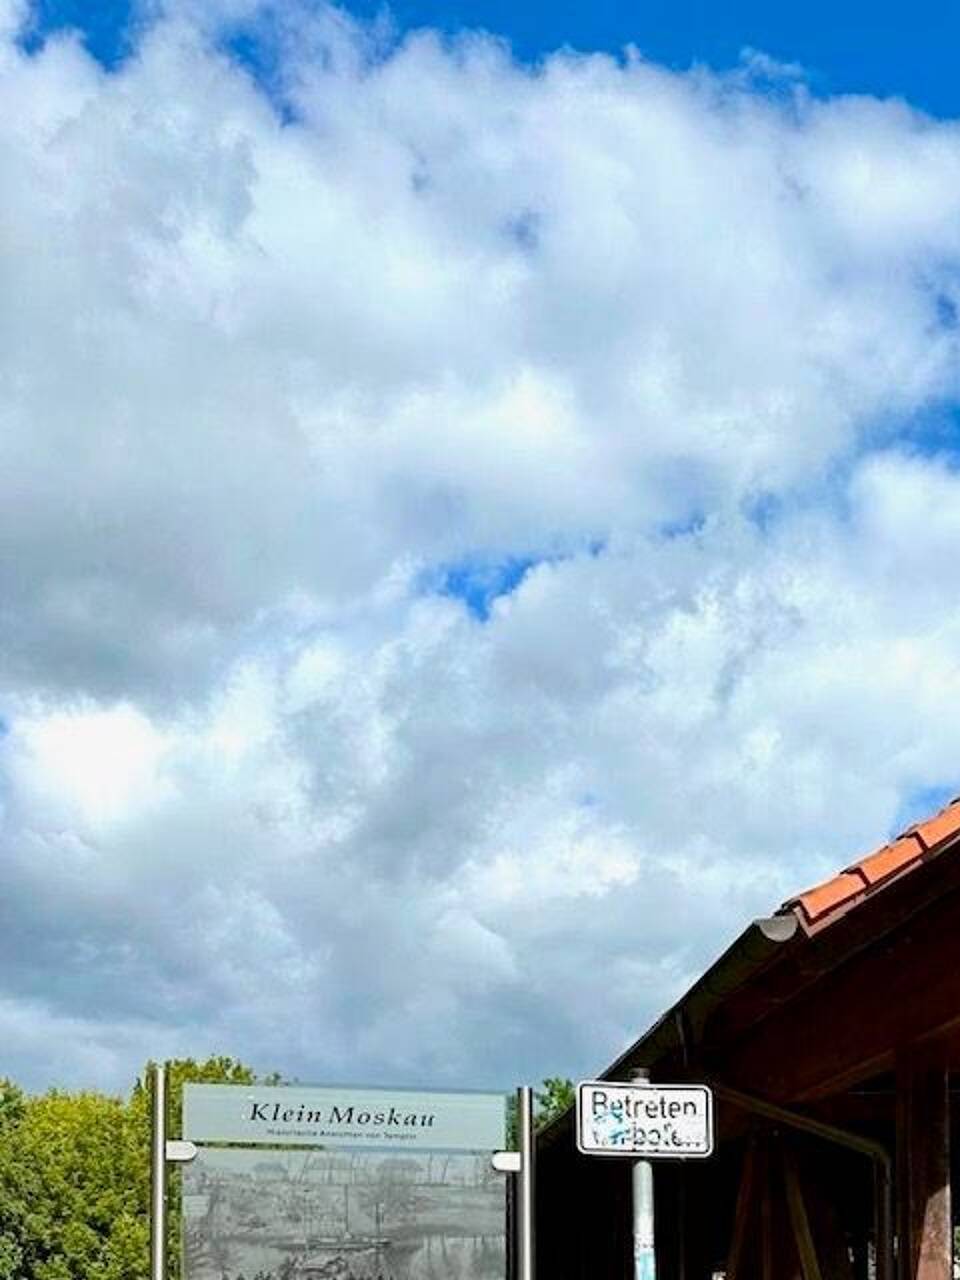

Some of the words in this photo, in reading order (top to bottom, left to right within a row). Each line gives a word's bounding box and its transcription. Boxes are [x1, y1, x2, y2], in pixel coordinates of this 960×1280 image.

[250, 1103, 321, 1122] Klein
[329, 1106, 436, 1127] Moskau
[592, 1091, 697, 1118] Betreten
